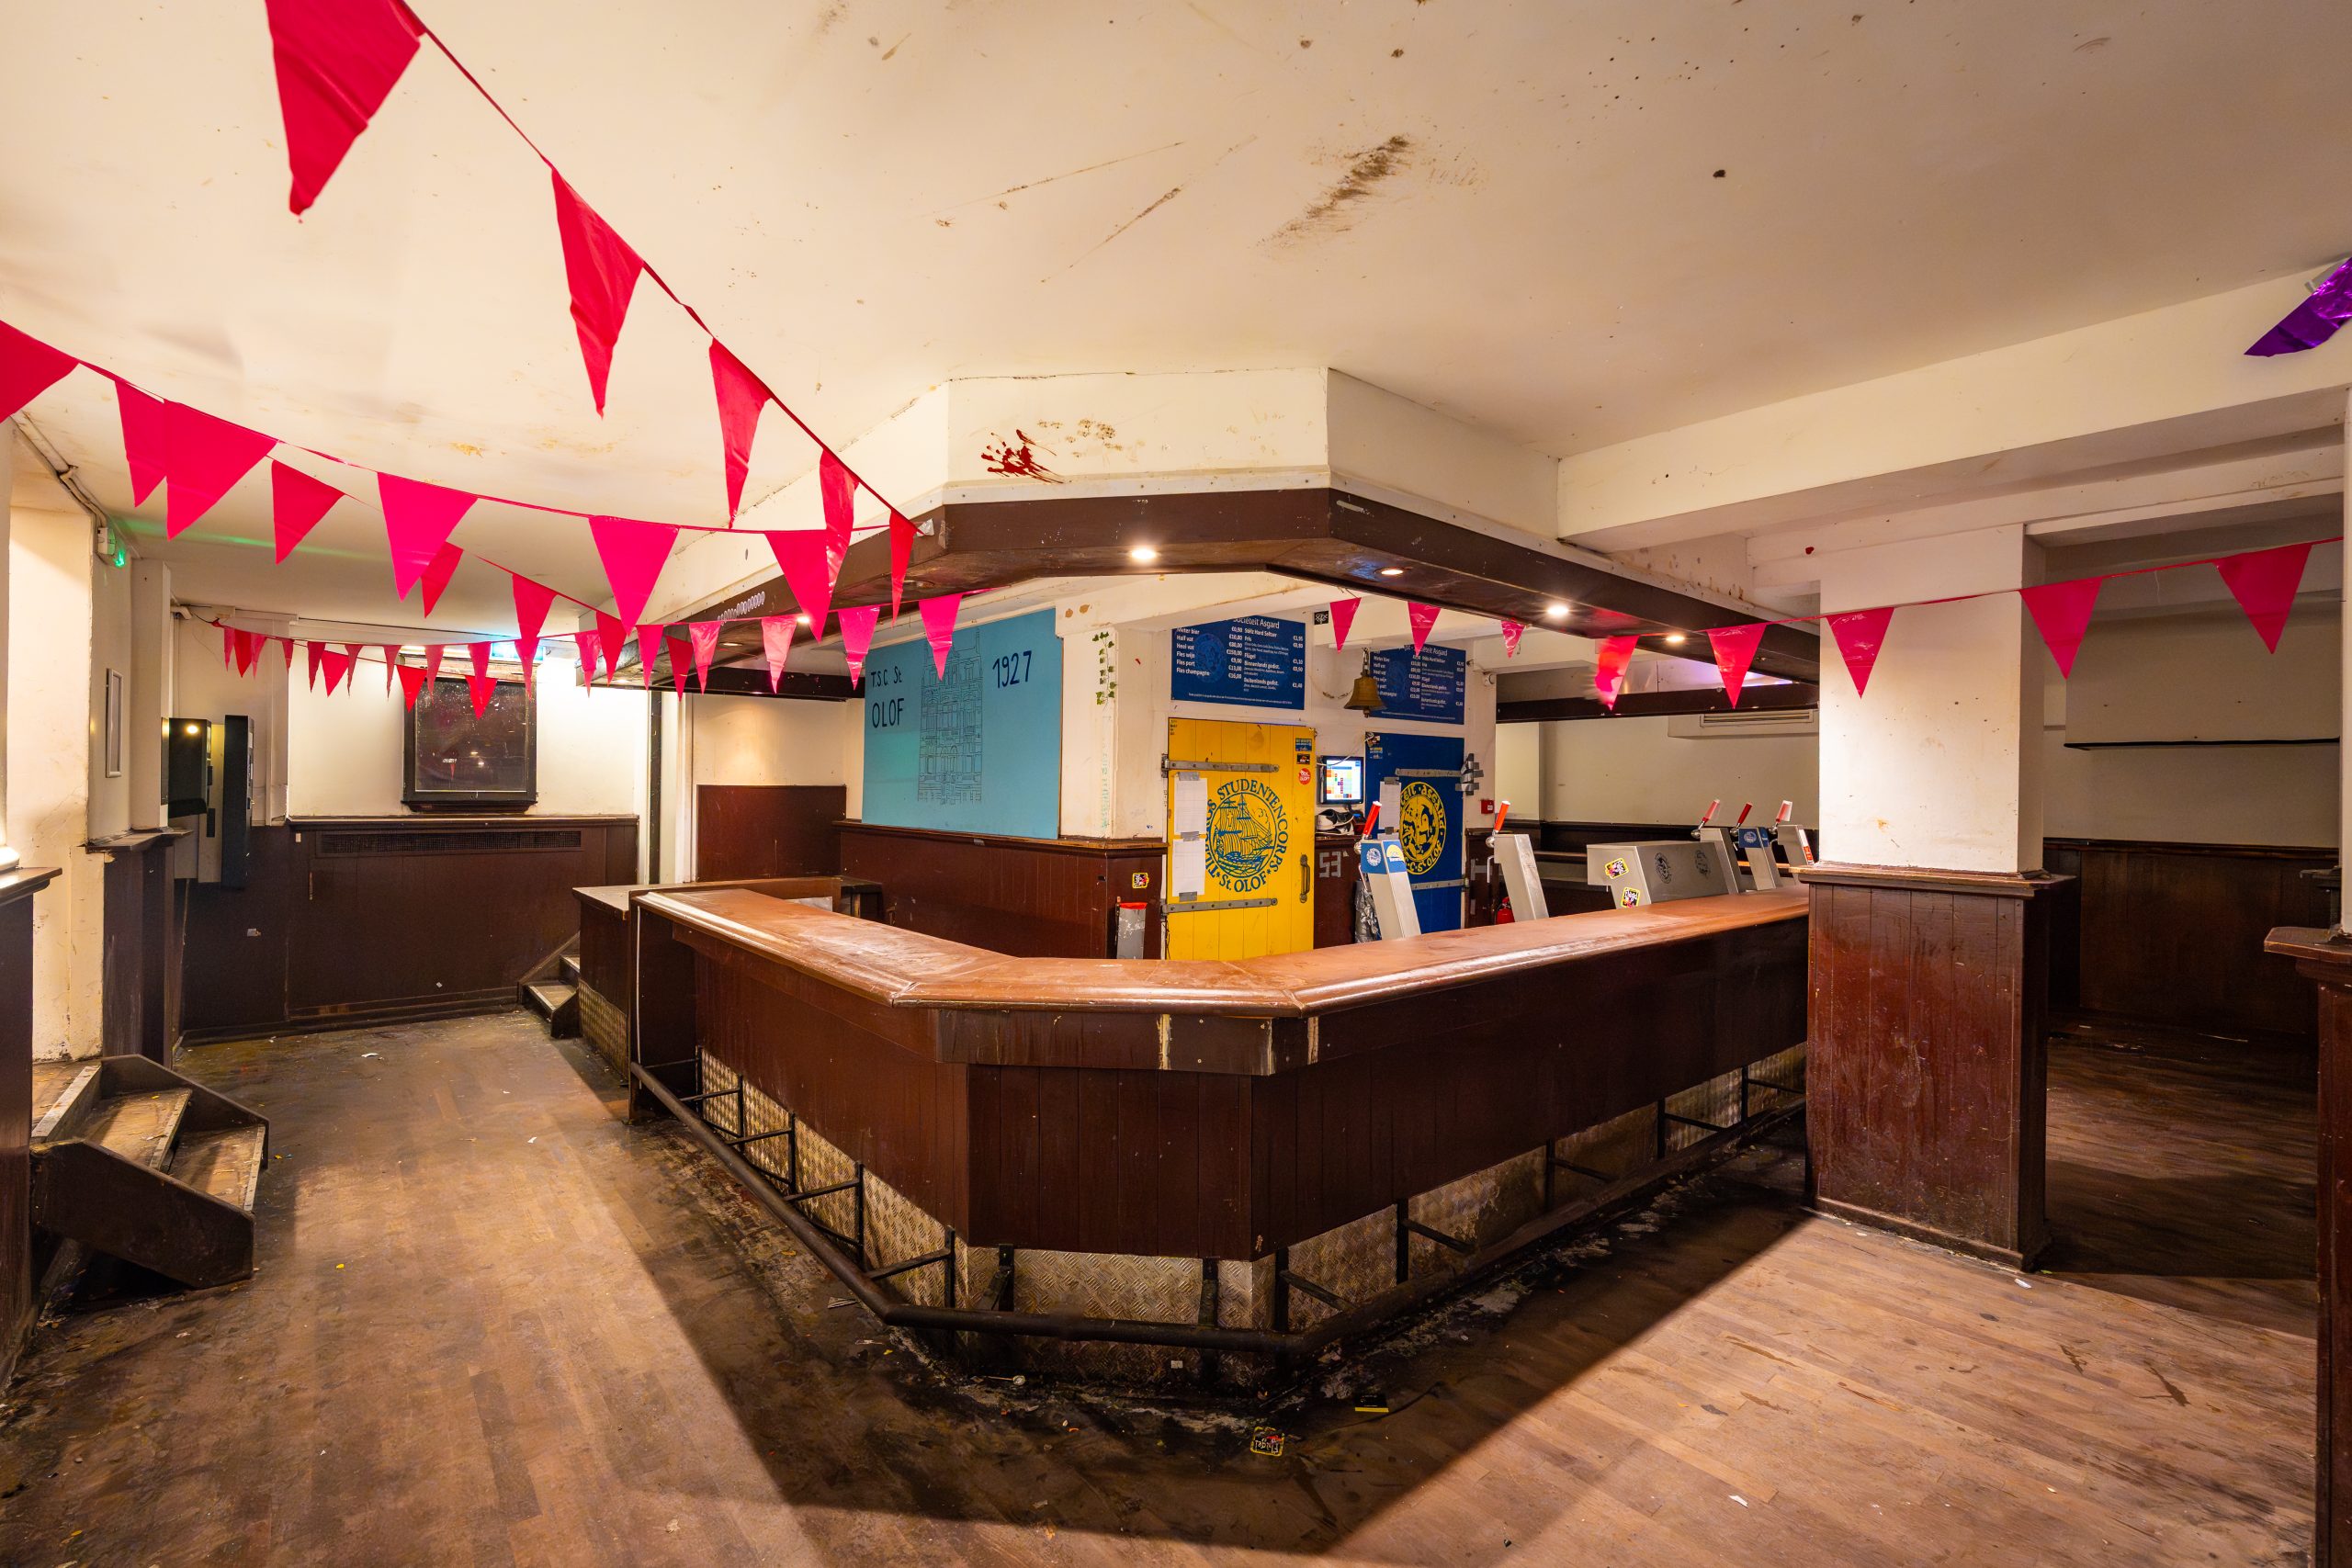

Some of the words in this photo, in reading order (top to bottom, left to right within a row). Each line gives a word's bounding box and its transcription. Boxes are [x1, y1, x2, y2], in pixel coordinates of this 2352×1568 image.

[1260, 618, 1280, 630] Asgard
[992, 649, 1032, 689] 1927
[872, 697, 905, 728] OLOF
[1216, 777, 1288, 873] STUDENTENCORPS
[1234, 871, 1267, 892] OLOF
